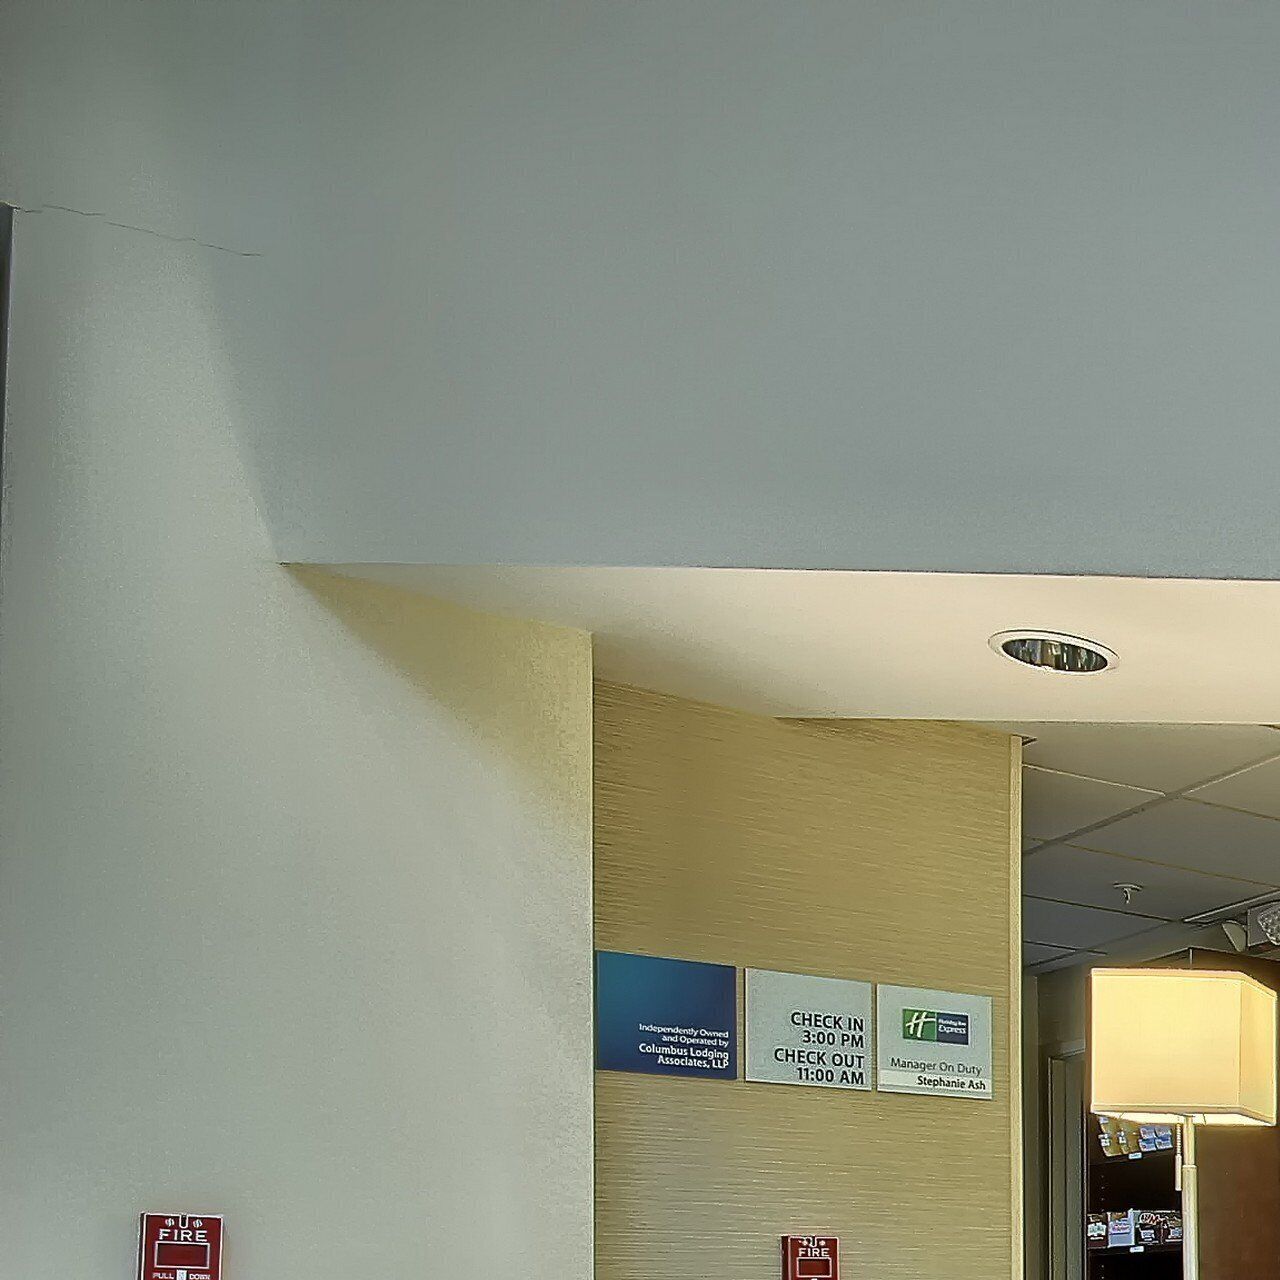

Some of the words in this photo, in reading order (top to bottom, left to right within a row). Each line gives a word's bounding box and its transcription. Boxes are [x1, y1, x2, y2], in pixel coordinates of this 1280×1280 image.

[791, 1012, 843, 1030] CHECK
[848, 1017, 864, 1032] IN
[938, 1025, 967, 1034] Express
[639, 1023, 699, 1037] Independently
[700, 1028, 729, 1038] Owned
[662, 1034, 678, 1042] and
[679, 1035, 717, 1046] Operated
[719, 1039, 729, 1048] by
[802, 1030, 836, 1046] 3:00
[841, 1033, 864, 1048] PM
[639, 1043, 688, 1056] Columbus
[690, 1047, 729, 1060] Lodging
[774, 1048, 827, 1065] CHECK
[832, 1053, 865, 1068] OUT
[657, 1054, 710, 1068] Associates,
[712, 1059, 729, 1069] LLP
[890, 1057, 937, 1073] Manager
[940, 1061, 954, 1072] On
[958, 1063, 983, 1077] Duty
[797, 1067, 835, 1082] 11:00
[840, 1070, 864, 1085] AM
[917, 1075, 966, 1088] Stephanie
[968, 1079, 986, 1090] Ash
[159, 1229, 207, 1241] FIRE
[798, 1248, 830, 1256] FIRE
